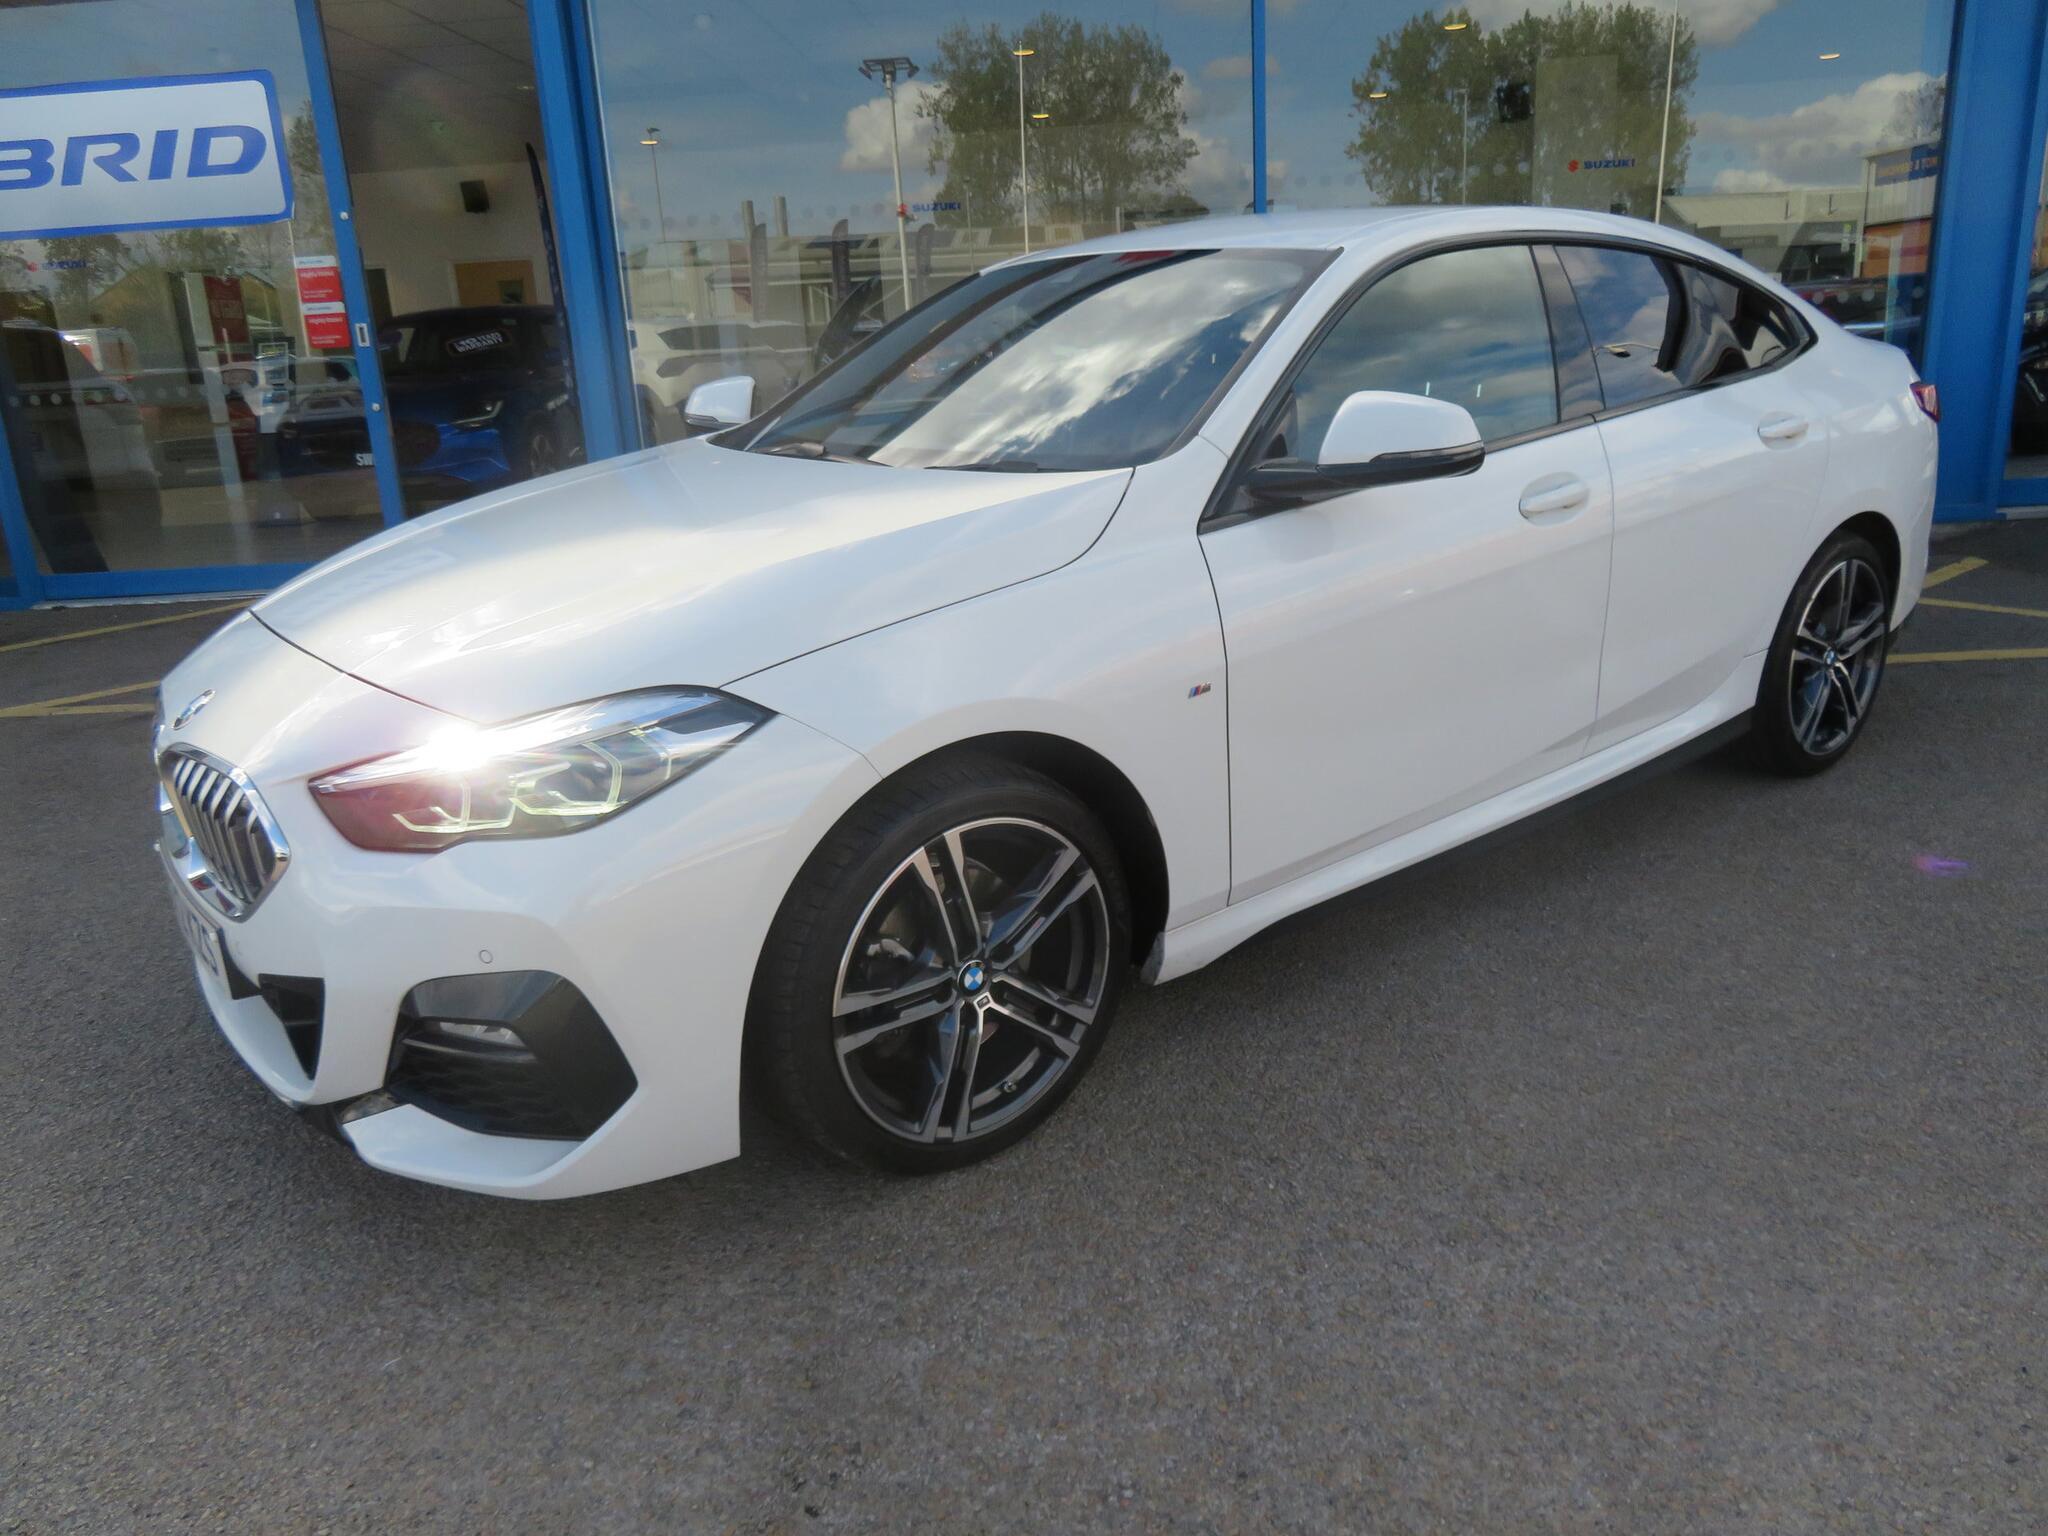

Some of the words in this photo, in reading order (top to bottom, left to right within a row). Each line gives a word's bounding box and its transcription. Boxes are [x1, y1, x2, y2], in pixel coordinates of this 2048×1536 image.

[0, 124, 267, 190] BRID
[1584, 159, 1635, 169] SUZUKI
[912, 202, 961, 212] SUZUKI
